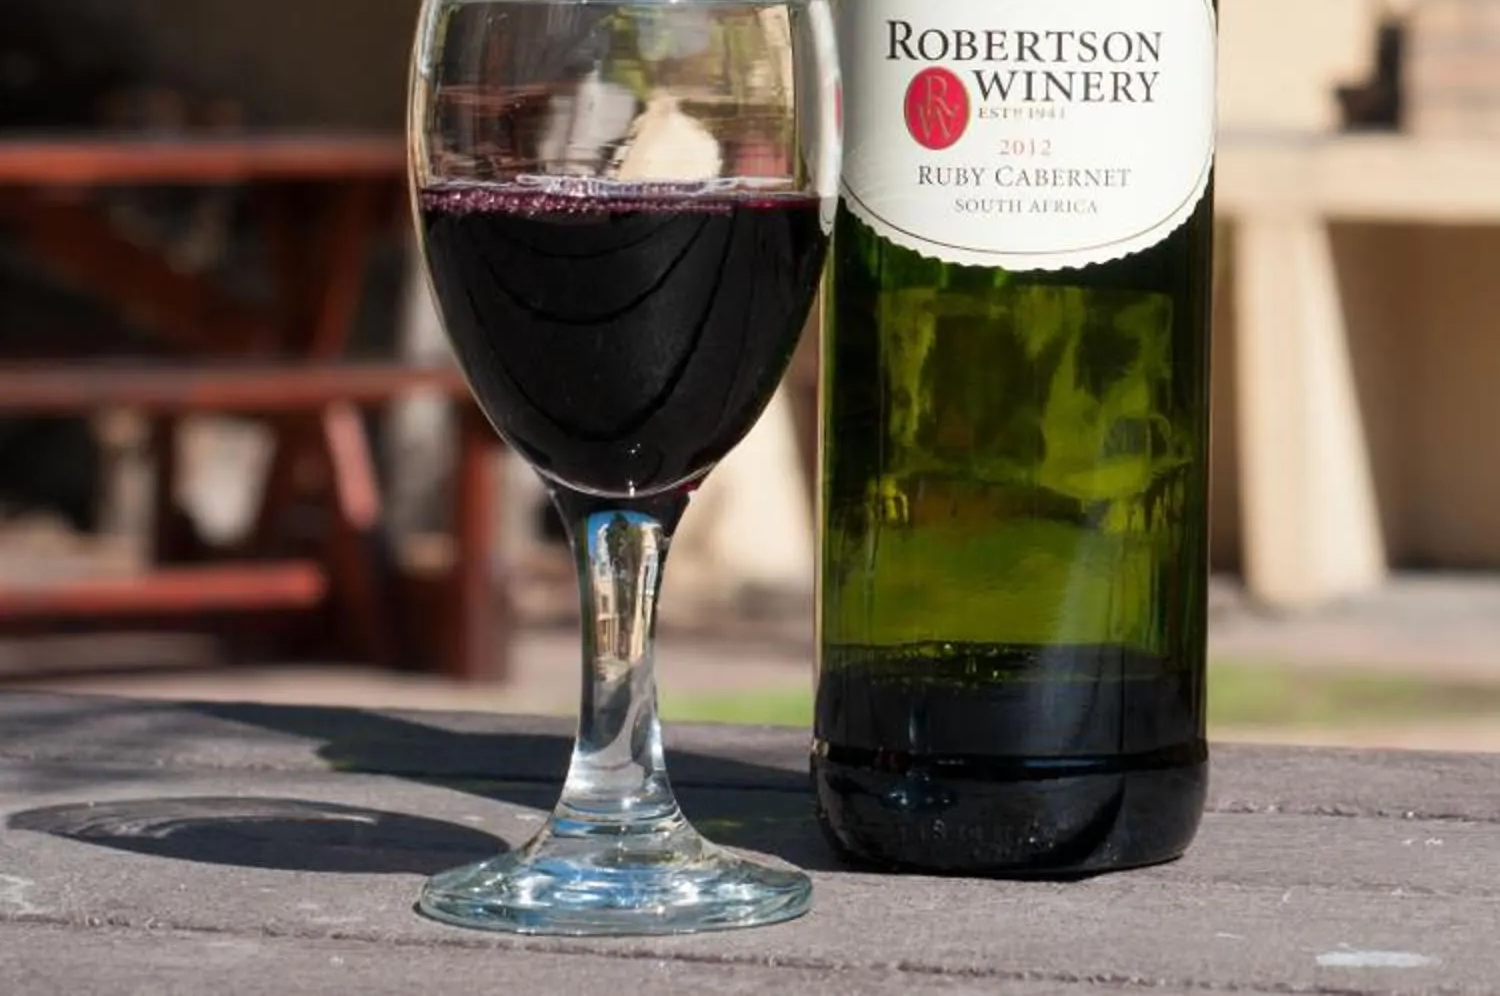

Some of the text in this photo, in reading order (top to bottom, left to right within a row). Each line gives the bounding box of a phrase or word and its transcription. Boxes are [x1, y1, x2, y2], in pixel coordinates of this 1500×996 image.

[886, 20, 1162, 63] ROBERTSON
[971, 69, 1160, 103] WINERY
[999, 138, 1052, 156] 2012
[917, 165, 1132, 188] RUBY CABERNET
[955, 197, 1099, 215] SOUTH AFRICA
